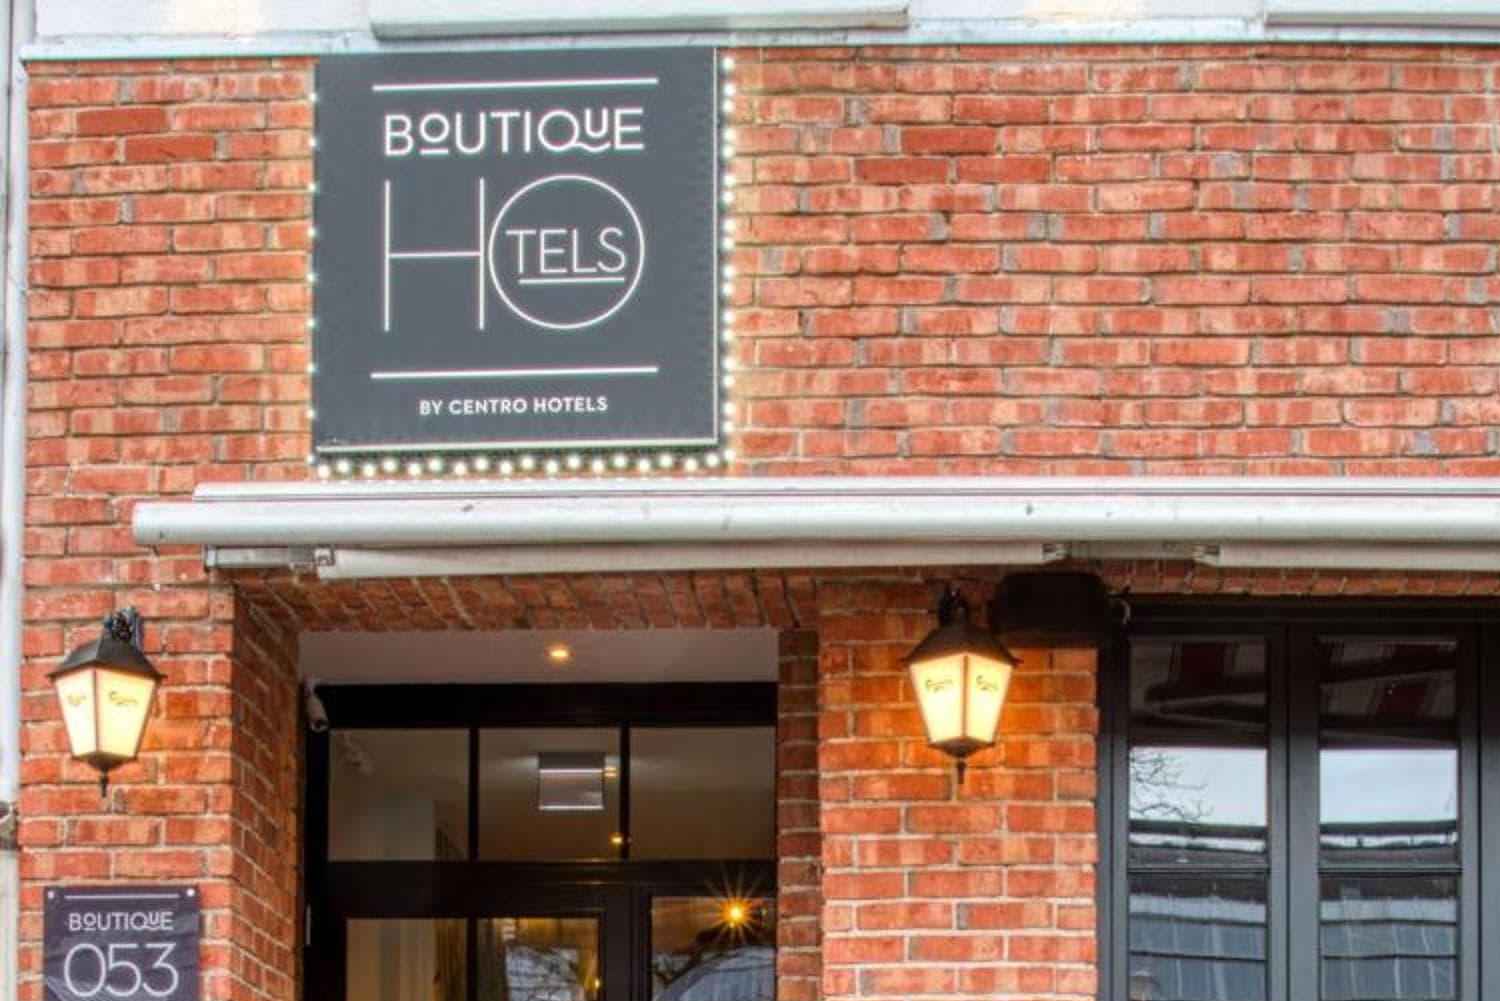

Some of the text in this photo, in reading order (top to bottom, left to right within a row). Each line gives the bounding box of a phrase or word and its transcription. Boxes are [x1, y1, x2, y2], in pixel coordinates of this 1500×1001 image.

[384, 107, 645, 156] BOUTIQUE
[419, 396, 608, 416] BY CENTRO HOTELS
[68, 911, 174, 931] BOUTIQUE
[63, 942, 179, 998] 053
